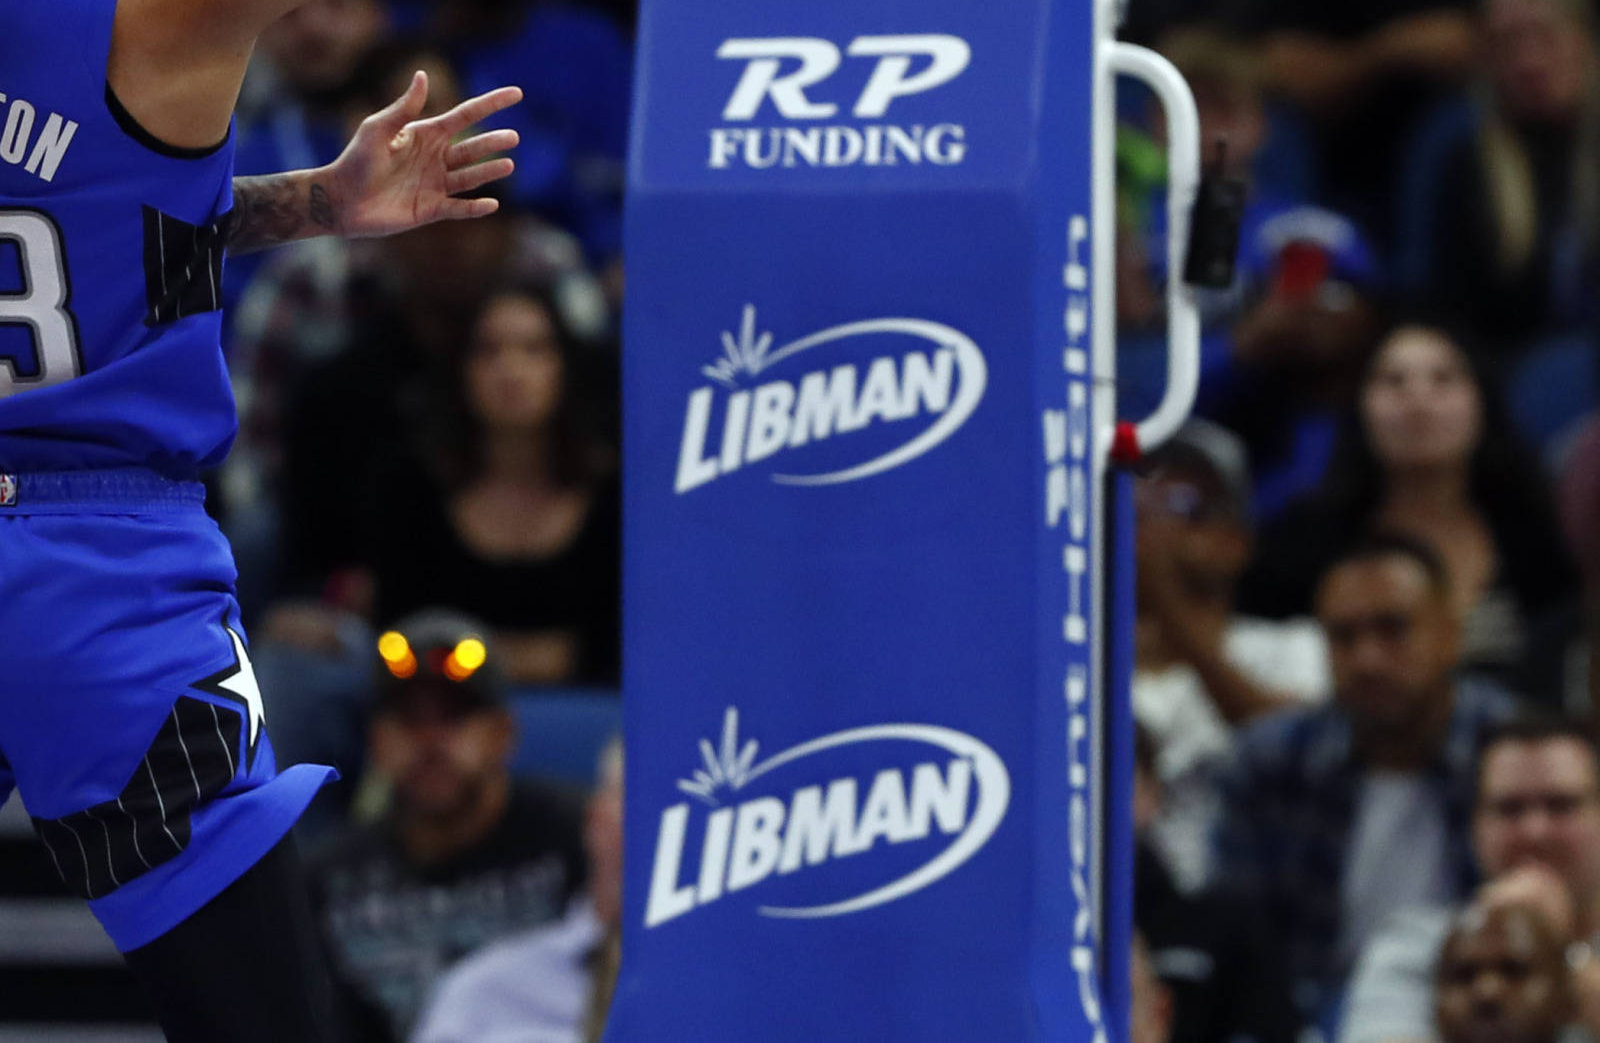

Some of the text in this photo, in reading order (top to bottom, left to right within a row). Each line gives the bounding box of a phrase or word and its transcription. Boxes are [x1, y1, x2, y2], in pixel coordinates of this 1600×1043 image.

[716, 33, 971, 121] RP
[708, 124, 966, 169] FUNDING
[674, 348, 954, 494] LIBMAN
[644, 759, 971, 929] LIBMAN
